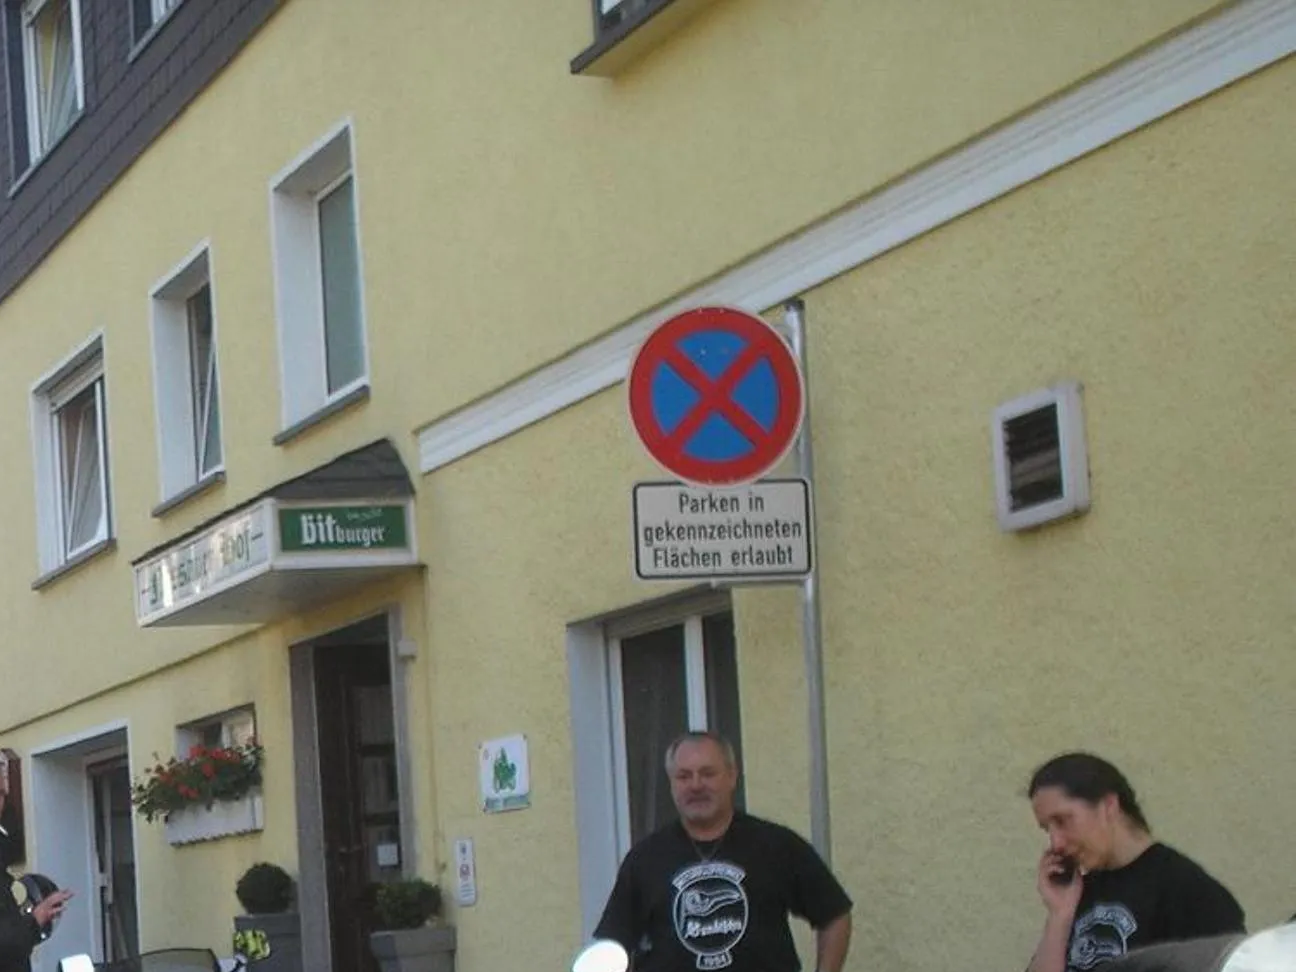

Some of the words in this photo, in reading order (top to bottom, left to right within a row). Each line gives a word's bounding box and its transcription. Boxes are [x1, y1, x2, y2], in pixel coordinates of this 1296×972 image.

[678, 493, 740, 514] Parken
[749, 492, 765, 511] in
[643, 519, 802, 546] gekennzeichneten
[653, 547, 722, 568] Flächen
[731, 545, 793, 566] erlaubt
